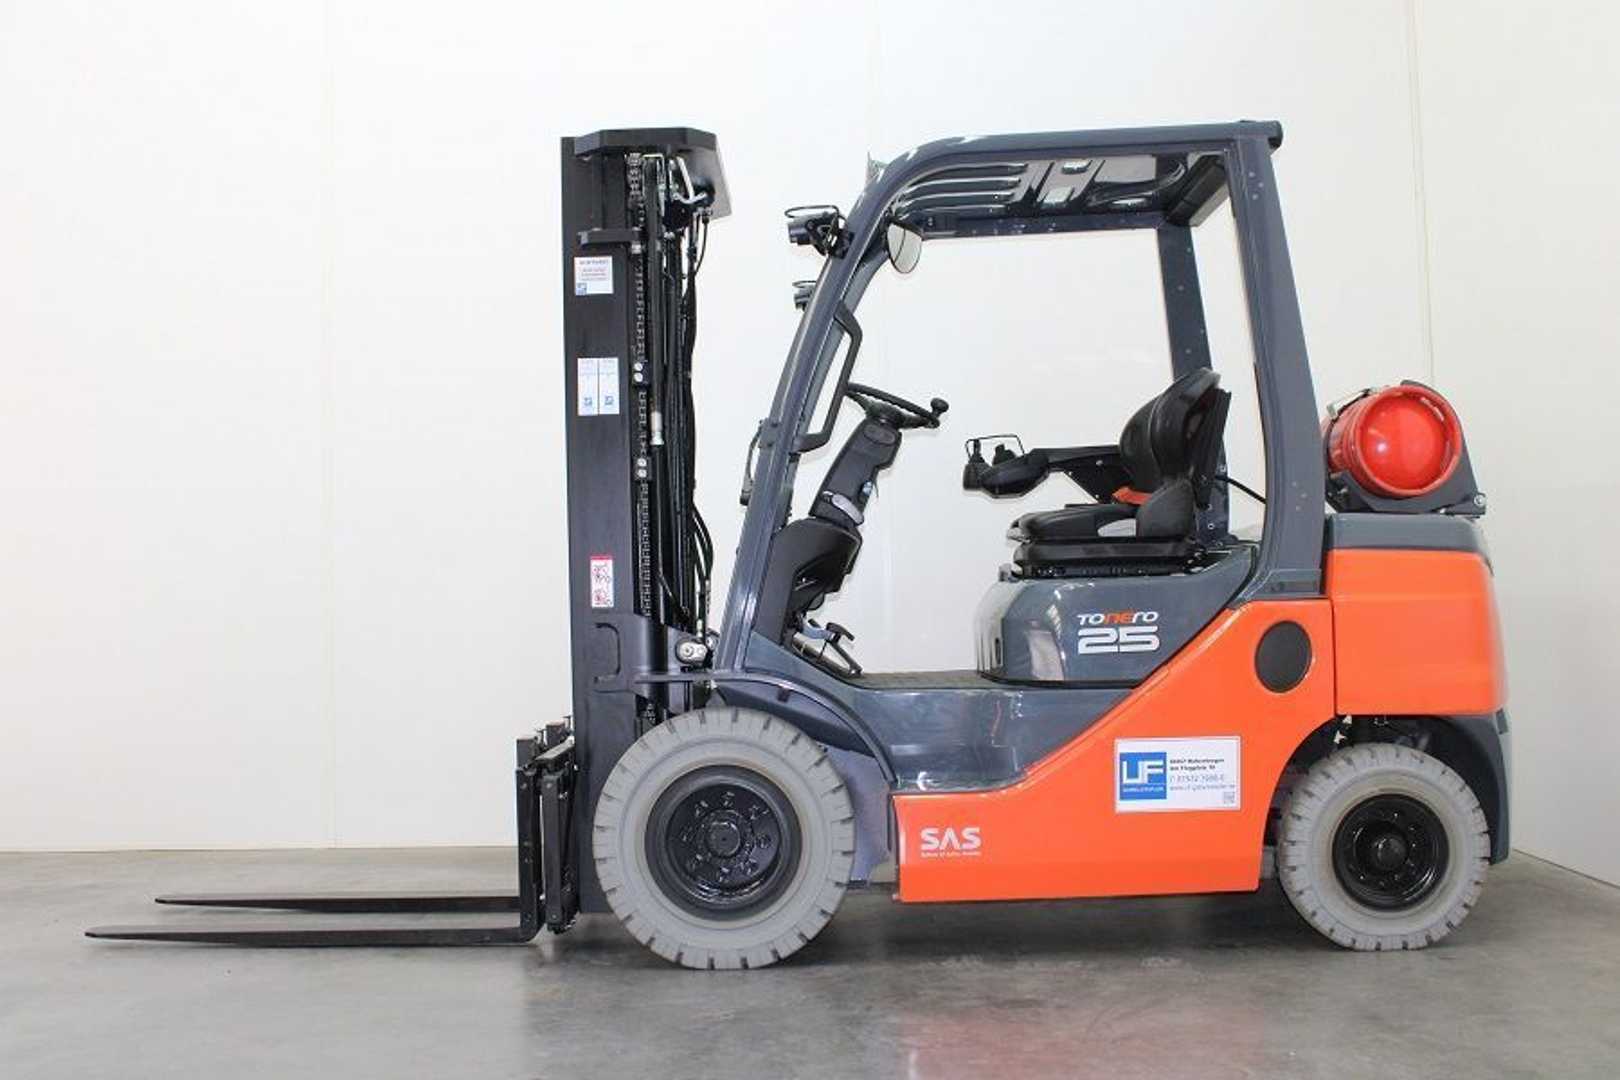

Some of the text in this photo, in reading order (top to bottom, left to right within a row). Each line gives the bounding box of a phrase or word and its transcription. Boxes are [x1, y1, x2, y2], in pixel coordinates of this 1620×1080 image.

[1078, 625, 1160, 654] 25
[1122, 760, 1163, 784] UF
[921, 827, 982, 850] SAS
